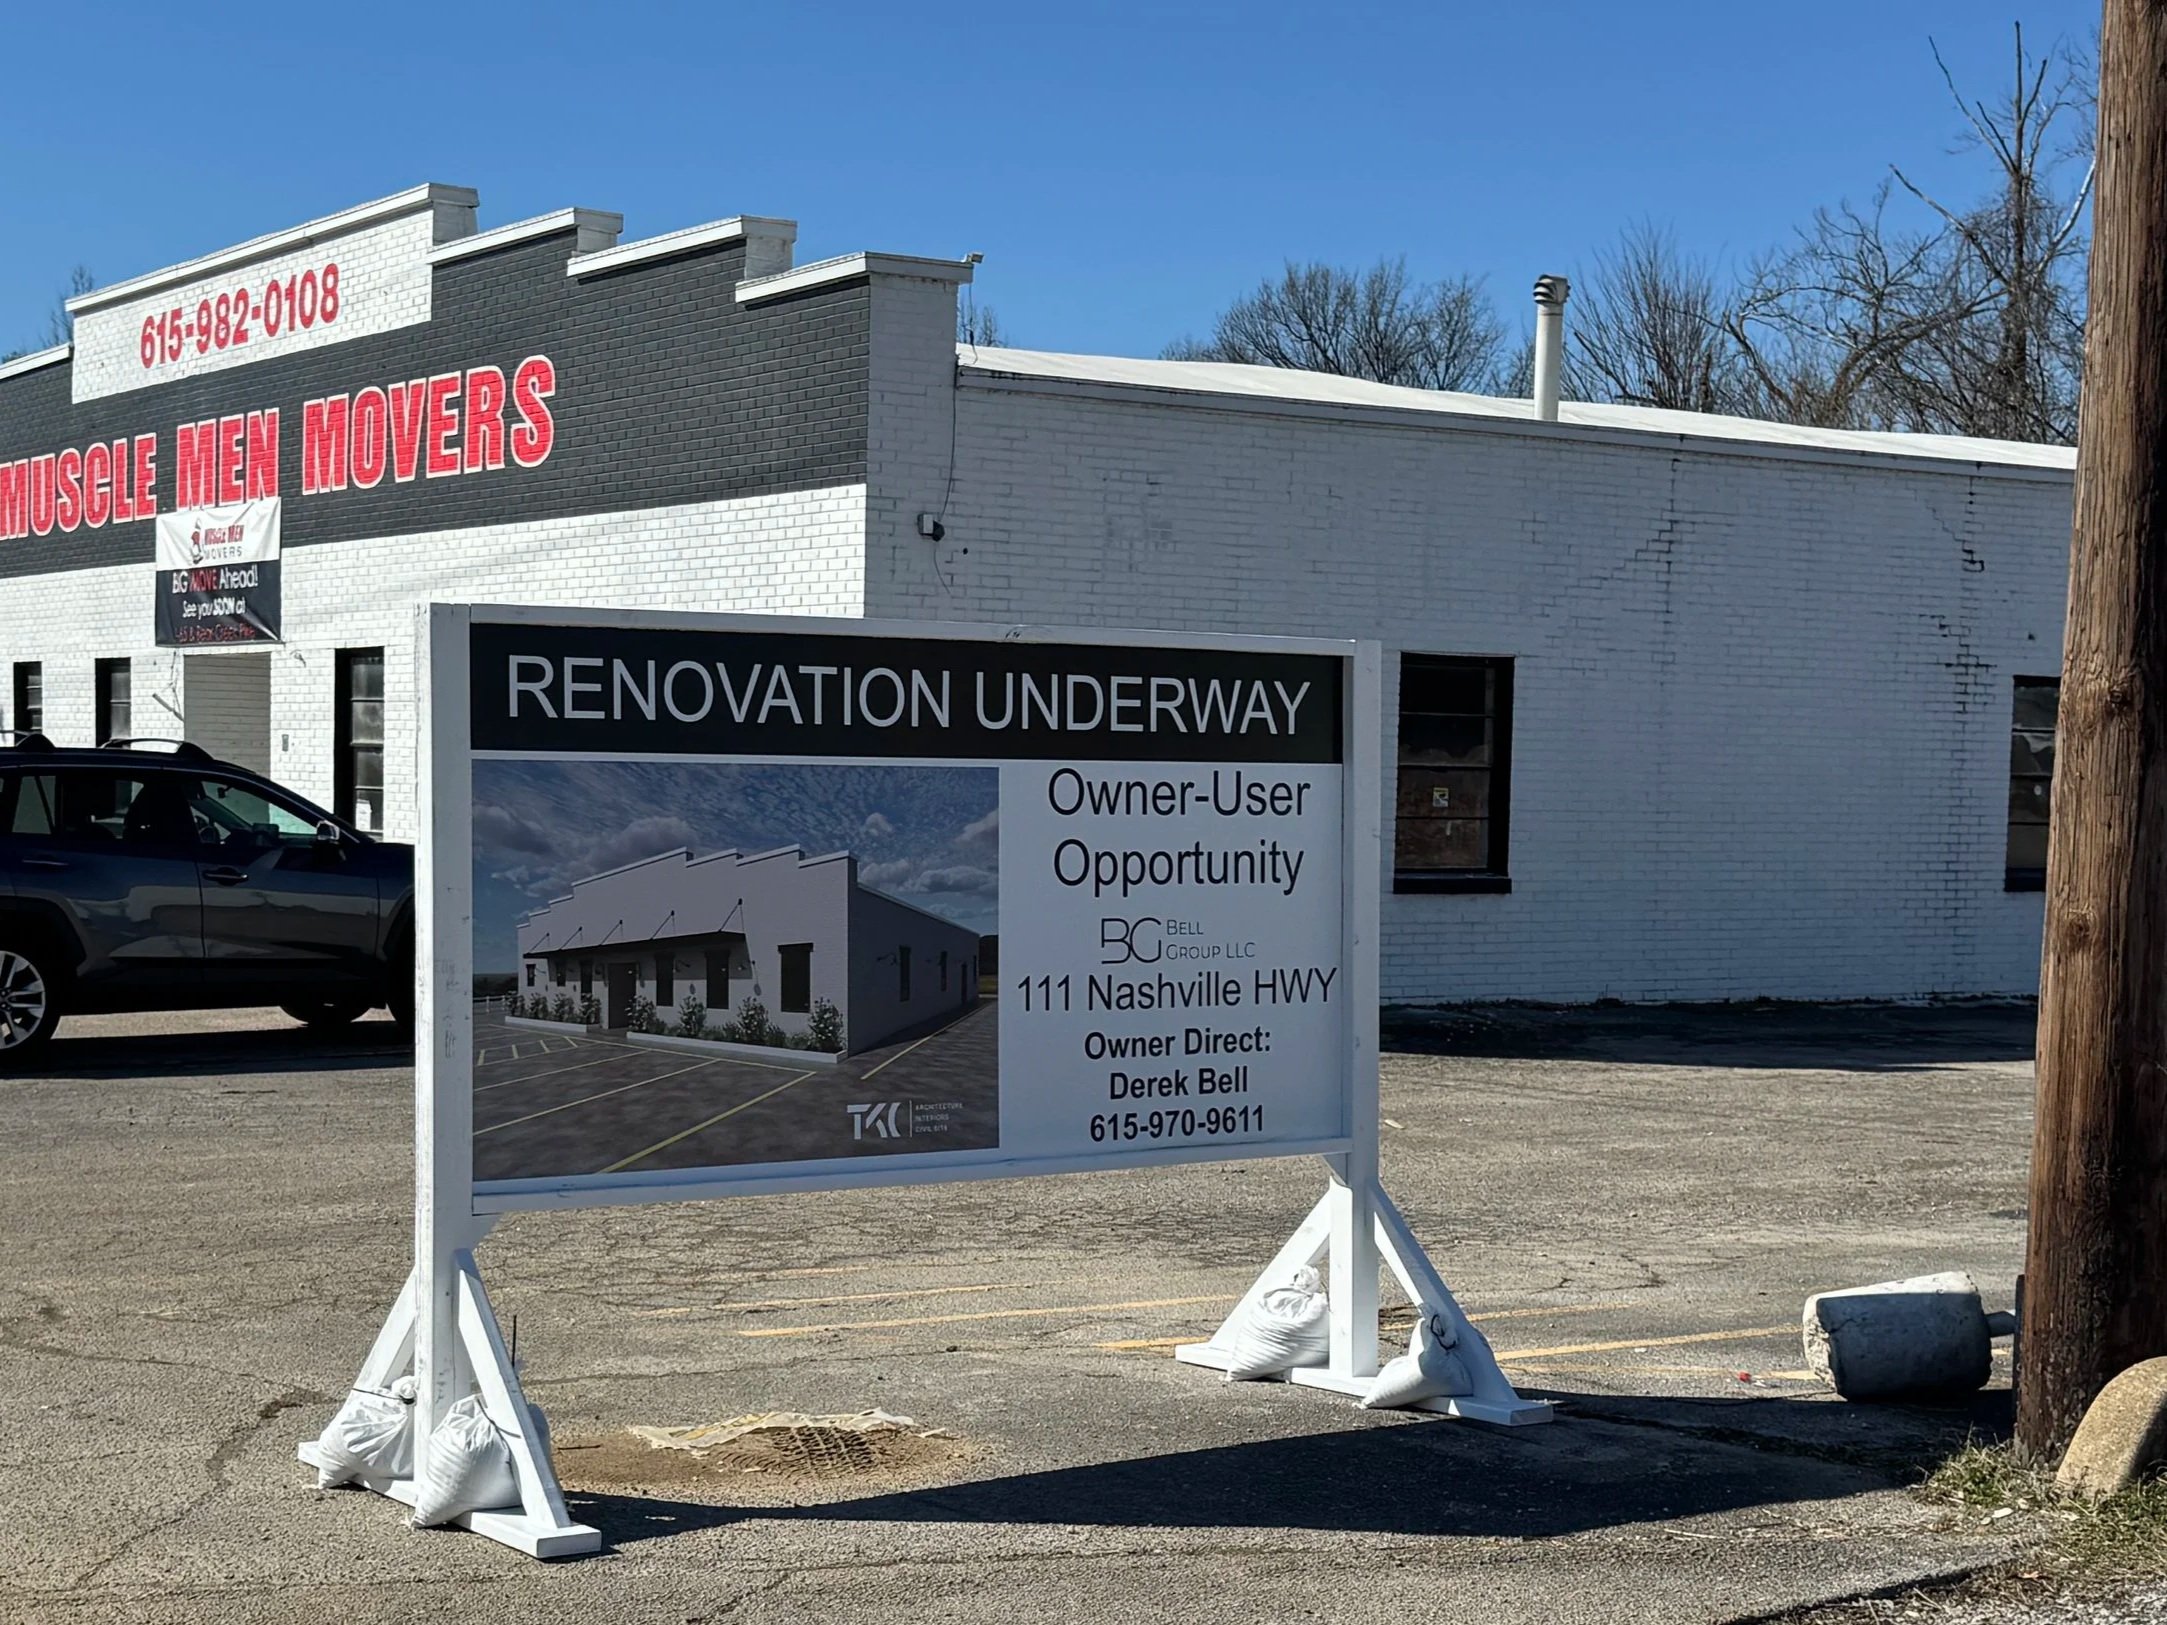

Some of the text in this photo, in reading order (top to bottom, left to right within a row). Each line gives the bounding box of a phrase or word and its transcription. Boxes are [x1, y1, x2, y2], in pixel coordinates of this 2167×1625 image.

[140, 263, 340, 369] 615-982-0108
[0, 354, 556, 540] MUSCLE MEN MOVERS
[219, 564, 259, 590] Ahead!
[182, 600, 198, 618] See
[198, 602, 213, 620] you
[508, 654, 1311, 736] RENOVATION UNDERWAY
[1048, 767, 1311, 817] Owner-User
[1053, 838, 1304, 898] Opportunity
[1226, 942, 1256, 959] LLC
[1017, 967, 1338, 1012] 111 Nashville HWY
[1084, 1026, 1271, 1060] Owner Direct:
[1110, 1065, 1248, 1100] Derek Bell
[1090, 1104, 1264, 1142] 615-970-9611
